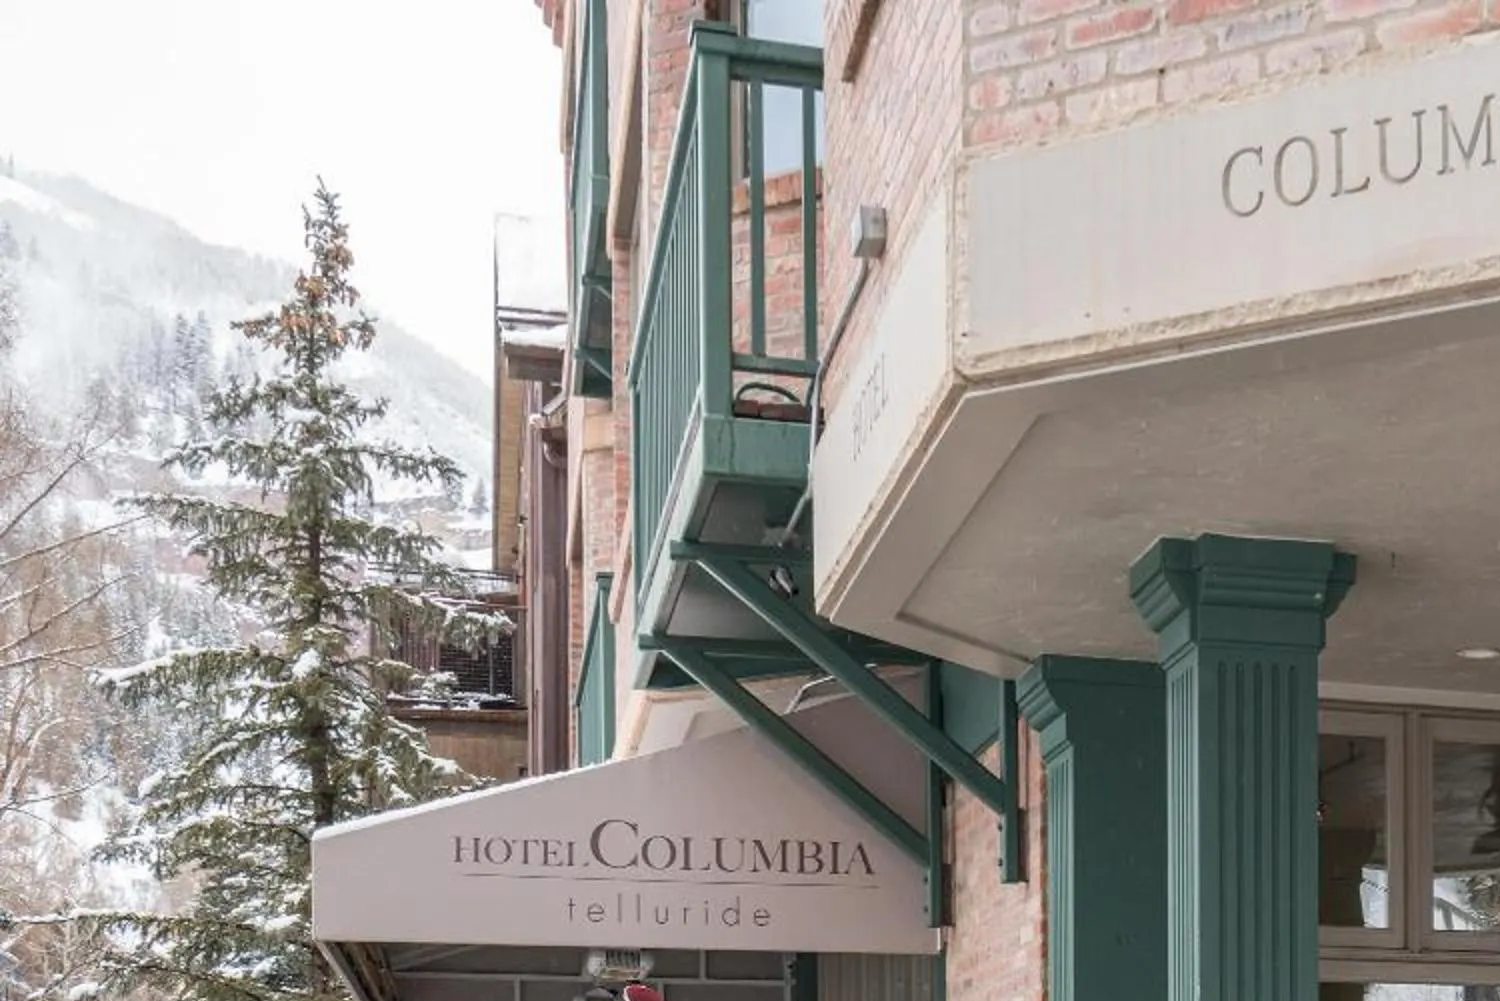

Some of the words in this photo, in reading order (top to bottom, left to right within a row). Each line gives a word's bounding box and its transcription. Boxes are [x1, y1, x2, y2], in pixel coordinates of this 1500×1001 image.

[453, 835, 590, 867] HOTEL
[590, 818, 877, 876] COLUMBIA
[568, 893, 772, 928] telluride
